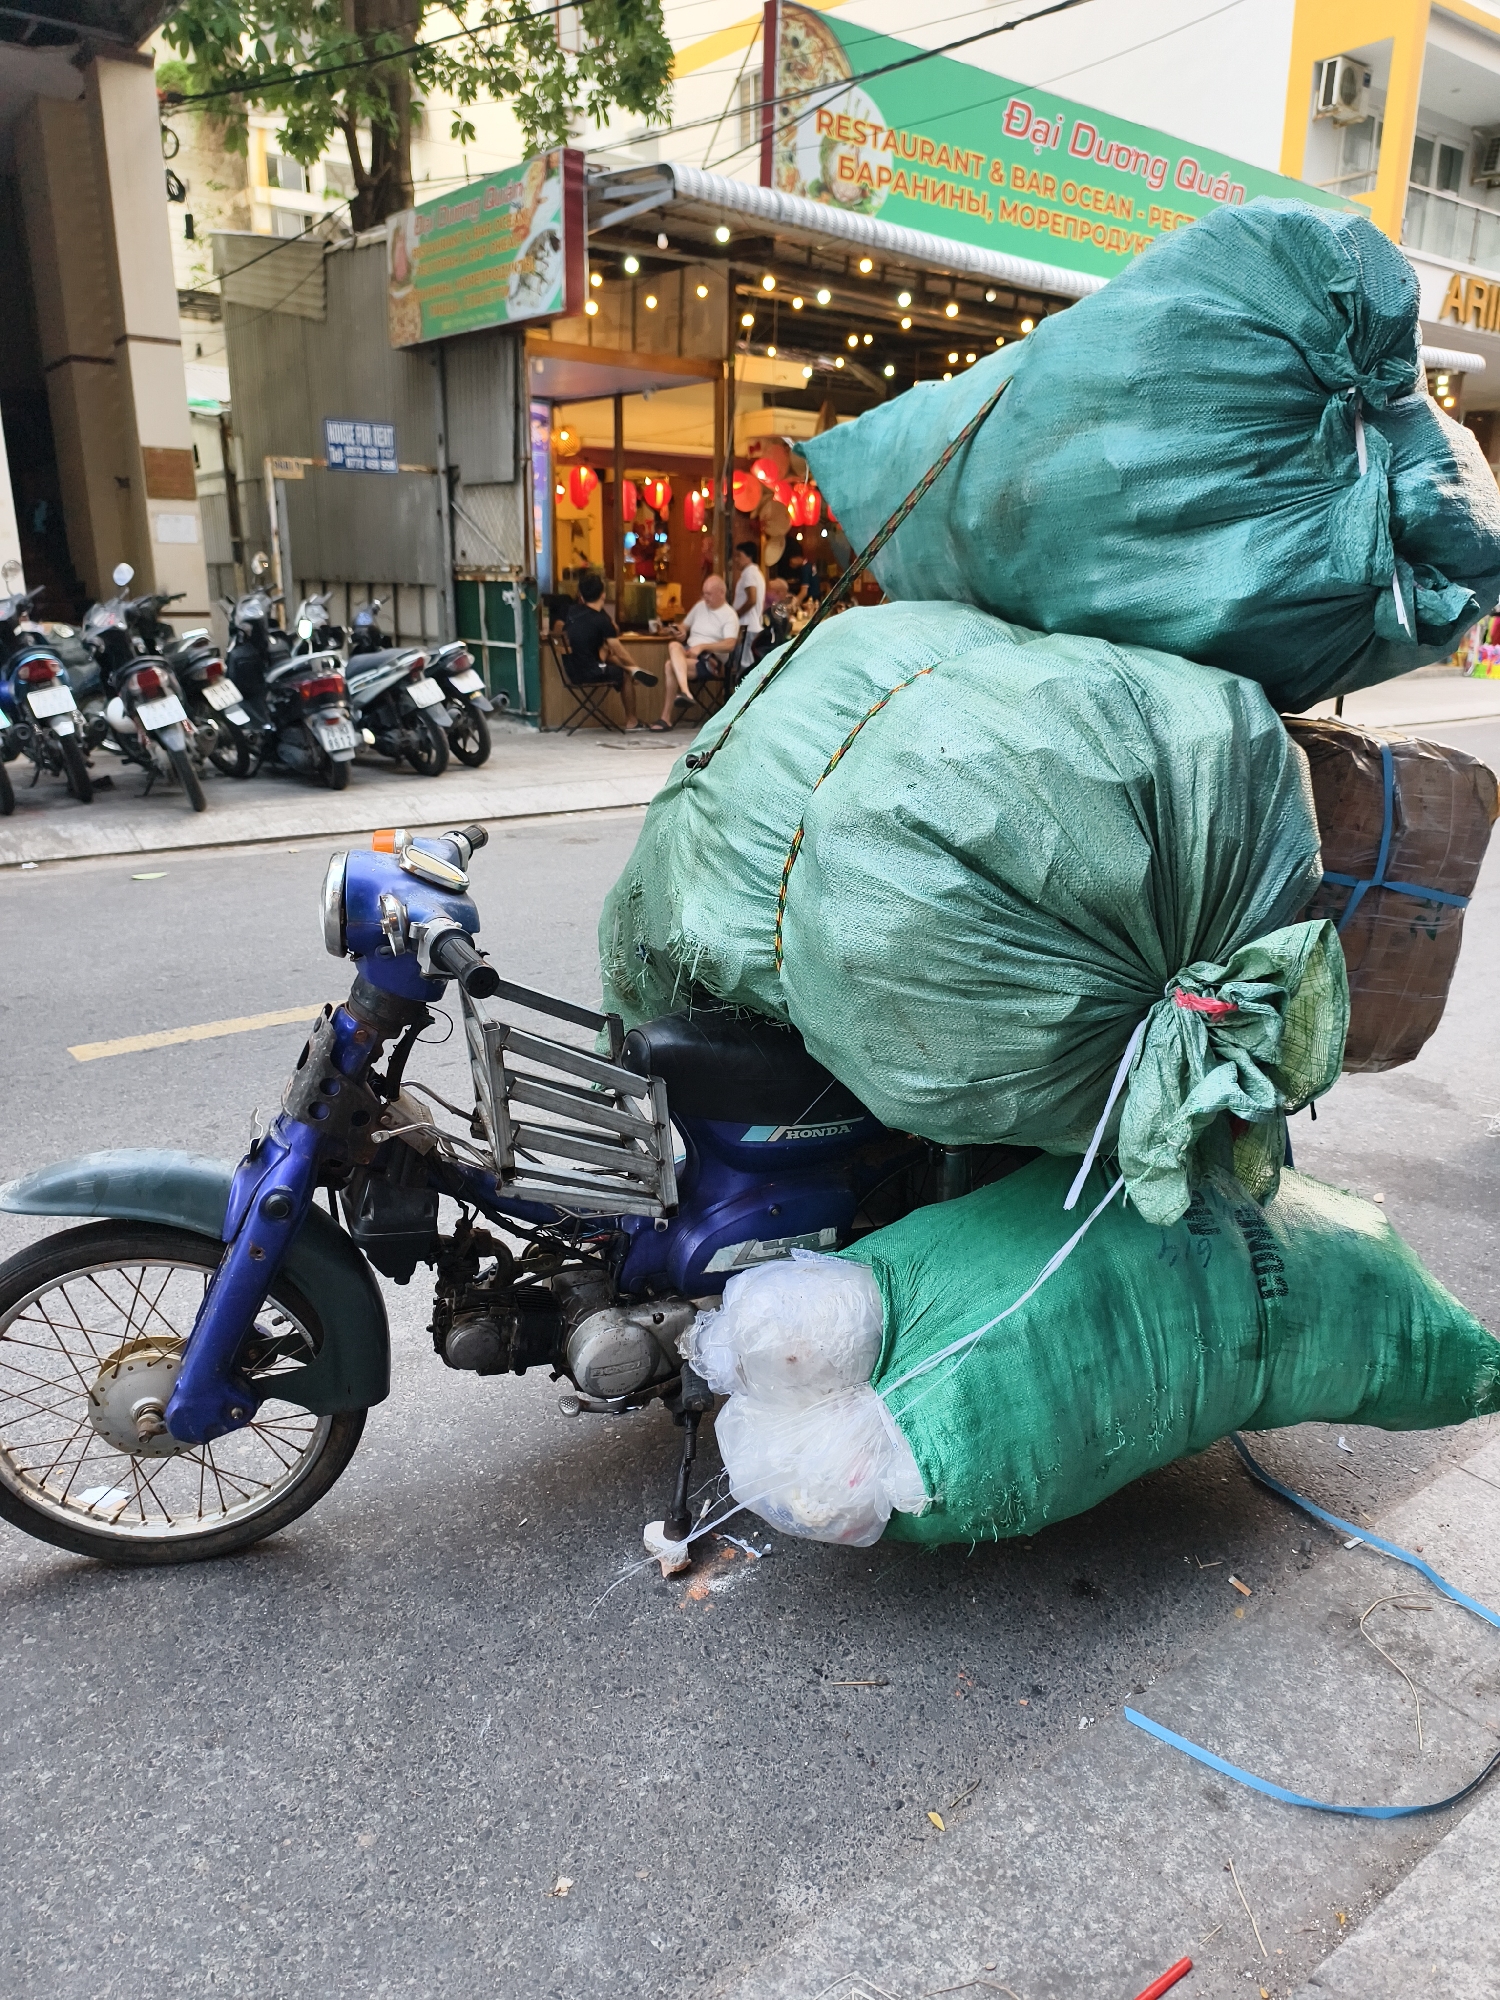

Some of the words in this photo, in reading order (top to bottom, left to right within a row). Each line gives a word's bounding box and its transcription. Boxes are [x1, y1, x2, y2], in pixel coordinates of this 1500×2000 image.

[815, 107, 985, 180] RESTAURANT
[988, 159, 1005, 186] &
[1010, 163, 1058, 201] BAR
[1061, 180, 1134, 222] OCEAN
[836, 154, 993, 224] БАРАНИНЫ,
[1003, 99, 1064, 155] Đại
[1069, 120, 1168, 191] Dương
[1174, 155, 1246, 206] Quán
[785, 1125, 851, 1139] HONDA
